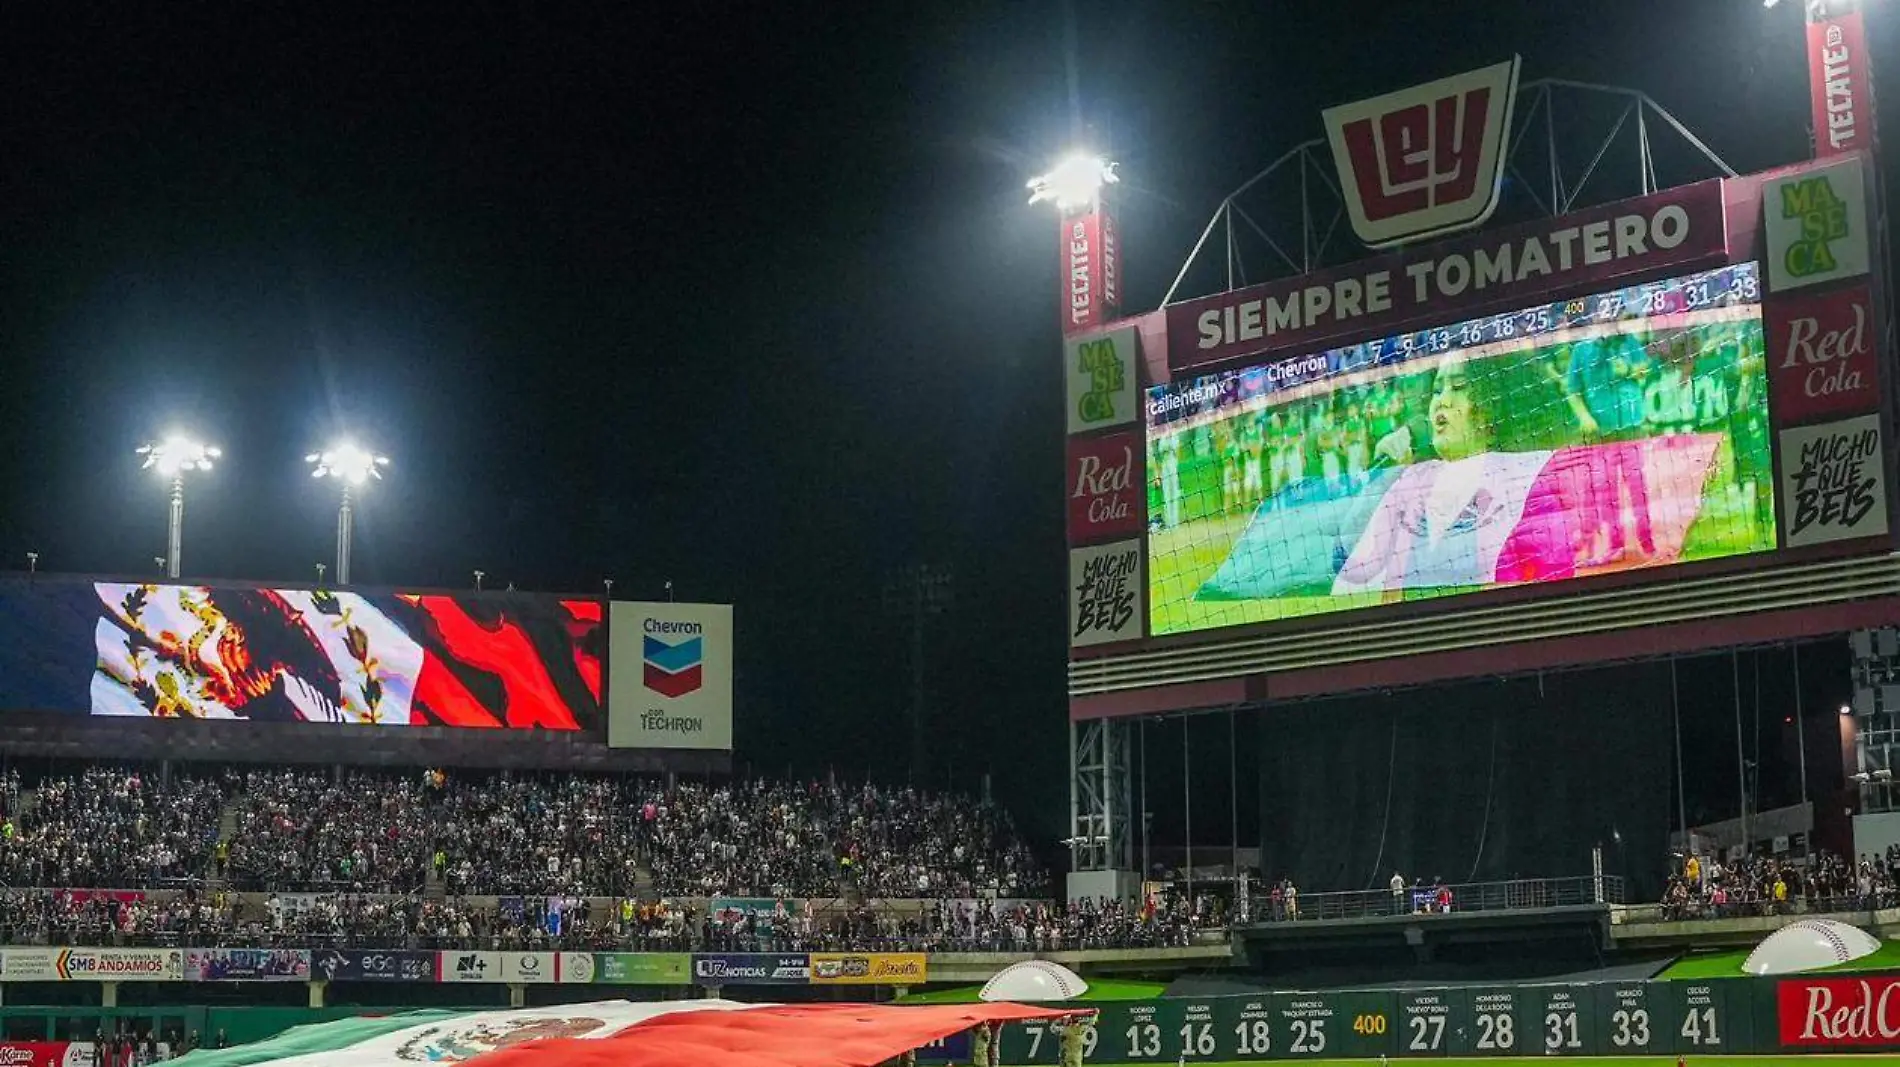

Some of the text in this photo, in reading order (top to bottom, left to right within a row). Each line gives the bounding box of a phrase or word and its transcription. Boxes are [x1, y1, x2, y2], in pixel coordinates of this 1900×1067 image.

[1823, 46, 1855, 149] TECATE
[1070, 239, 1090, 323] TECATE
[1198, 205, 1690, 348] SIEMPRE TOMATERO
[1731, 276, 1756, 299] 33
[1564, 302, 1584, 315] 400
[1599, 297, 1624, 319] 27
[1643, 290, 1666, 312] 28
[1686, 284, 1710, 306] 31
[1460, 324, 1482, 345] 16
[1492, 317, 1514, 337] 18
[1525, 311, 1548, 331] 25
[1780, 303, 1870, 368] Red
[1371, 340, 1385, 363] 7
[1429, 331, 1450, 351] 13
[1268, 354, 1327, 382] Chevron
[1805, 361, 1861, 397] Cola
[1150, 382, 1226, 415] caliente.mx
[1801, 429, 1878, 469] MUCHO
[1072, 446, 1132, 498] Red
[1089, 494, 1128, 523] Cola
[1083, 551, 1138, 582] MUCHO
[643, 618, 702, 634] Chevron
[641, 714, 702, 733] TECHRON
[648, 709, 664, 717] con
[70, 958, 96, 971] SM8
[98, 961, 162, 972] ANDAMIOS
[1800, 980, 1876, 1038] Red
[1180, 1023, 1215, 1055] 16
[1235, 1021, 1271, 1054] 18
[1290, 1020, 1325, 1052] 25
[1353, 1015, 1385, 1034] 400
[1410, 1016, 1446, 1050] 27
[1477, 1014, 1514, 1048] 28
[1545, 1012, 1582, 1048] 31
[1613, 1010, 1649, 1046] 33
[1681, 1008, 1721, 1045] 41
[1026, 1028, 1043, 1058] 7
[1126, 1025, 1161, 1057] 13
